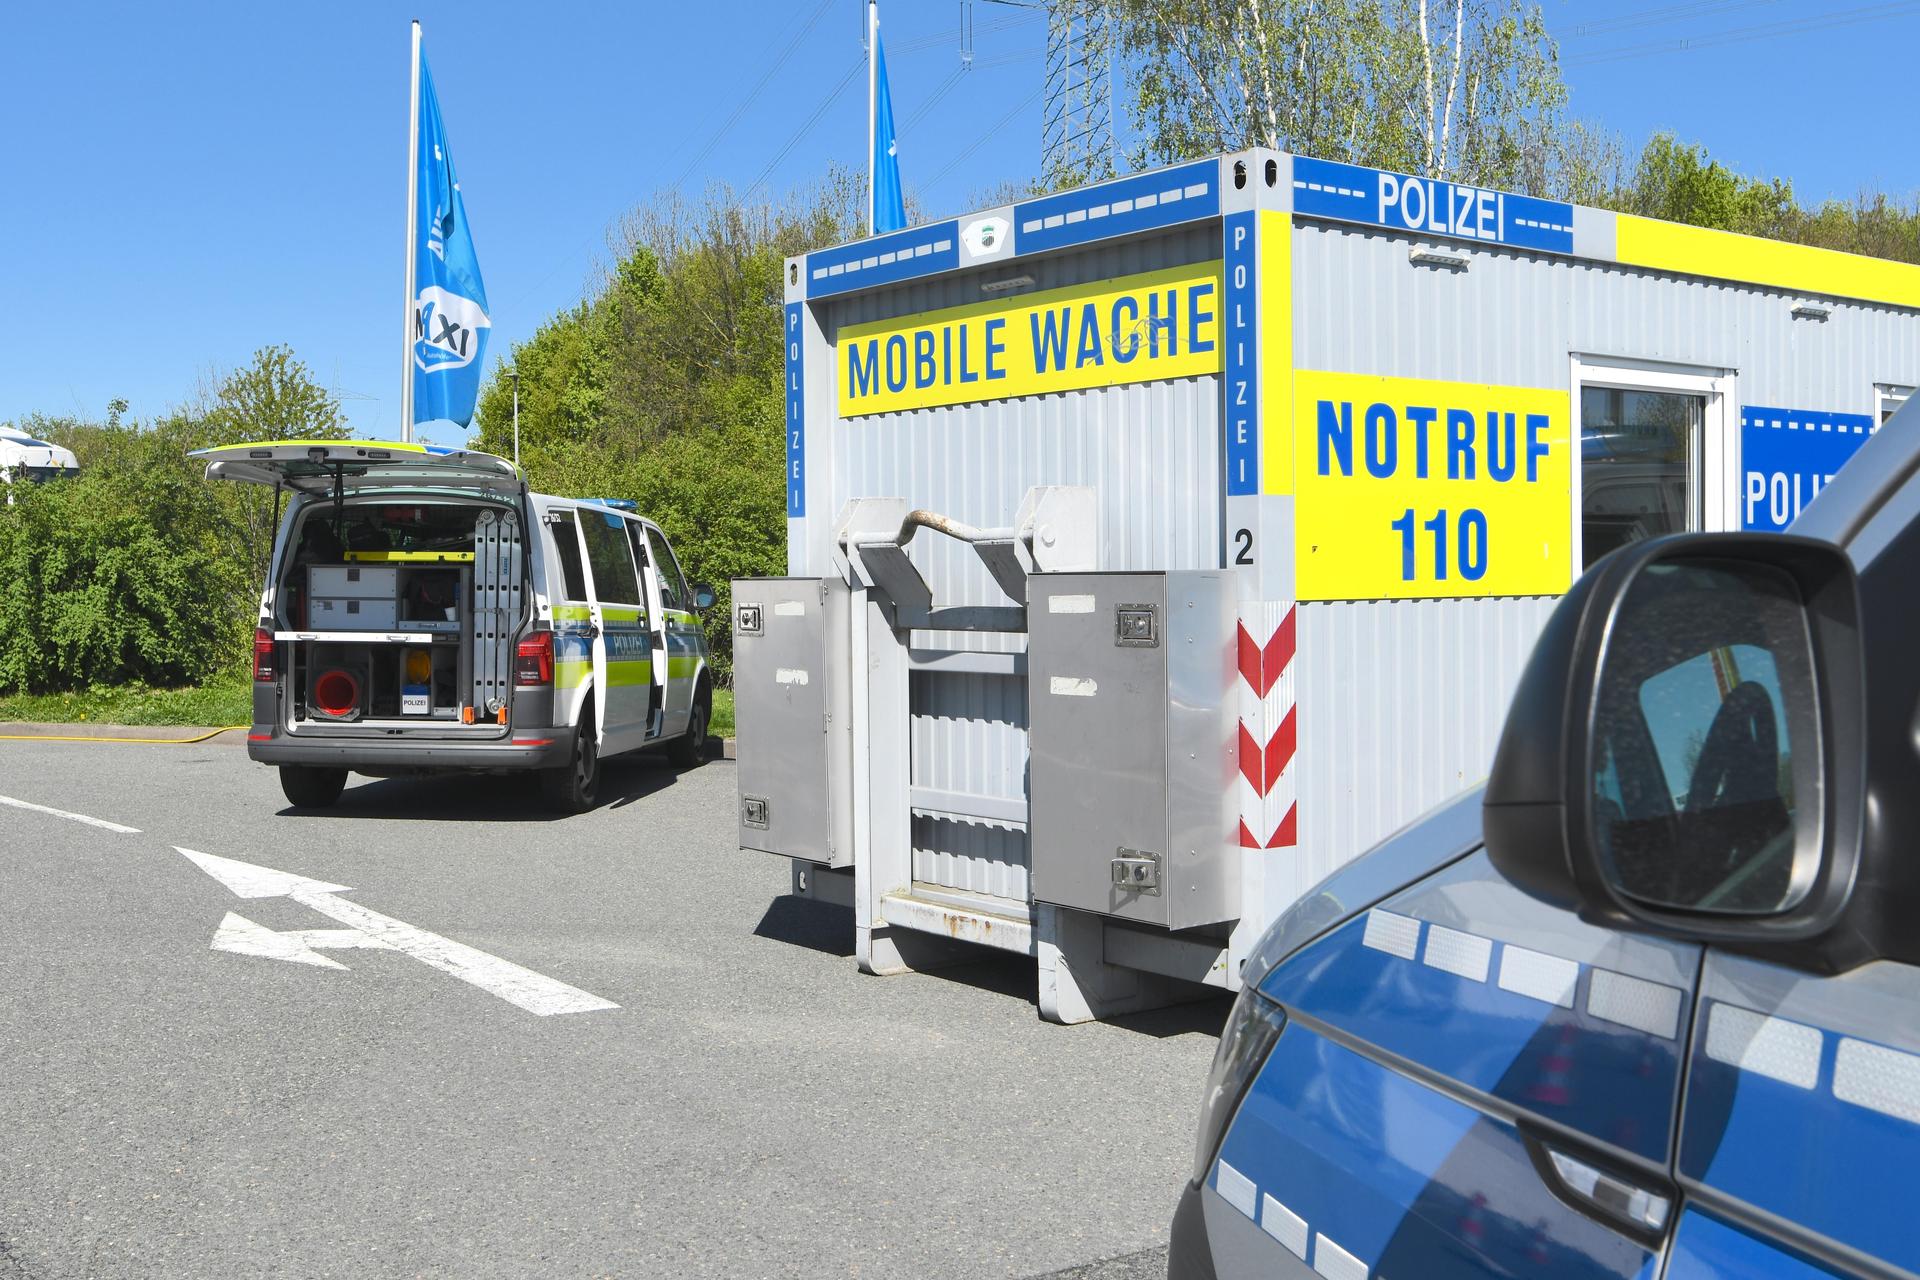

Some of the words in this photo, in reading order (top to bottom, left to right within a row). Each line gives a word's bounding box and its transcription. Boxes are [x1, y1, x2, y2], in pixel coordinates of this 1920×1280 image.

[1378, 173, 1504, 242] POLIZEI
[848, 317, 1007, 399] MOBILE
[1029, 283, 1215, 374] WACHE
[1234, 226, 1247, 482] POLIZEI
[790, 313, 800, 508] POLIZEI
[1316, 400, 1550, 483] NOTRUF
[1746, 471, 1836, 526] POL
[1234, 528, 1254, 565] 2
[1391, 508, 1488, 581] 110
[613, 634, 643, 655] POLIZEI
